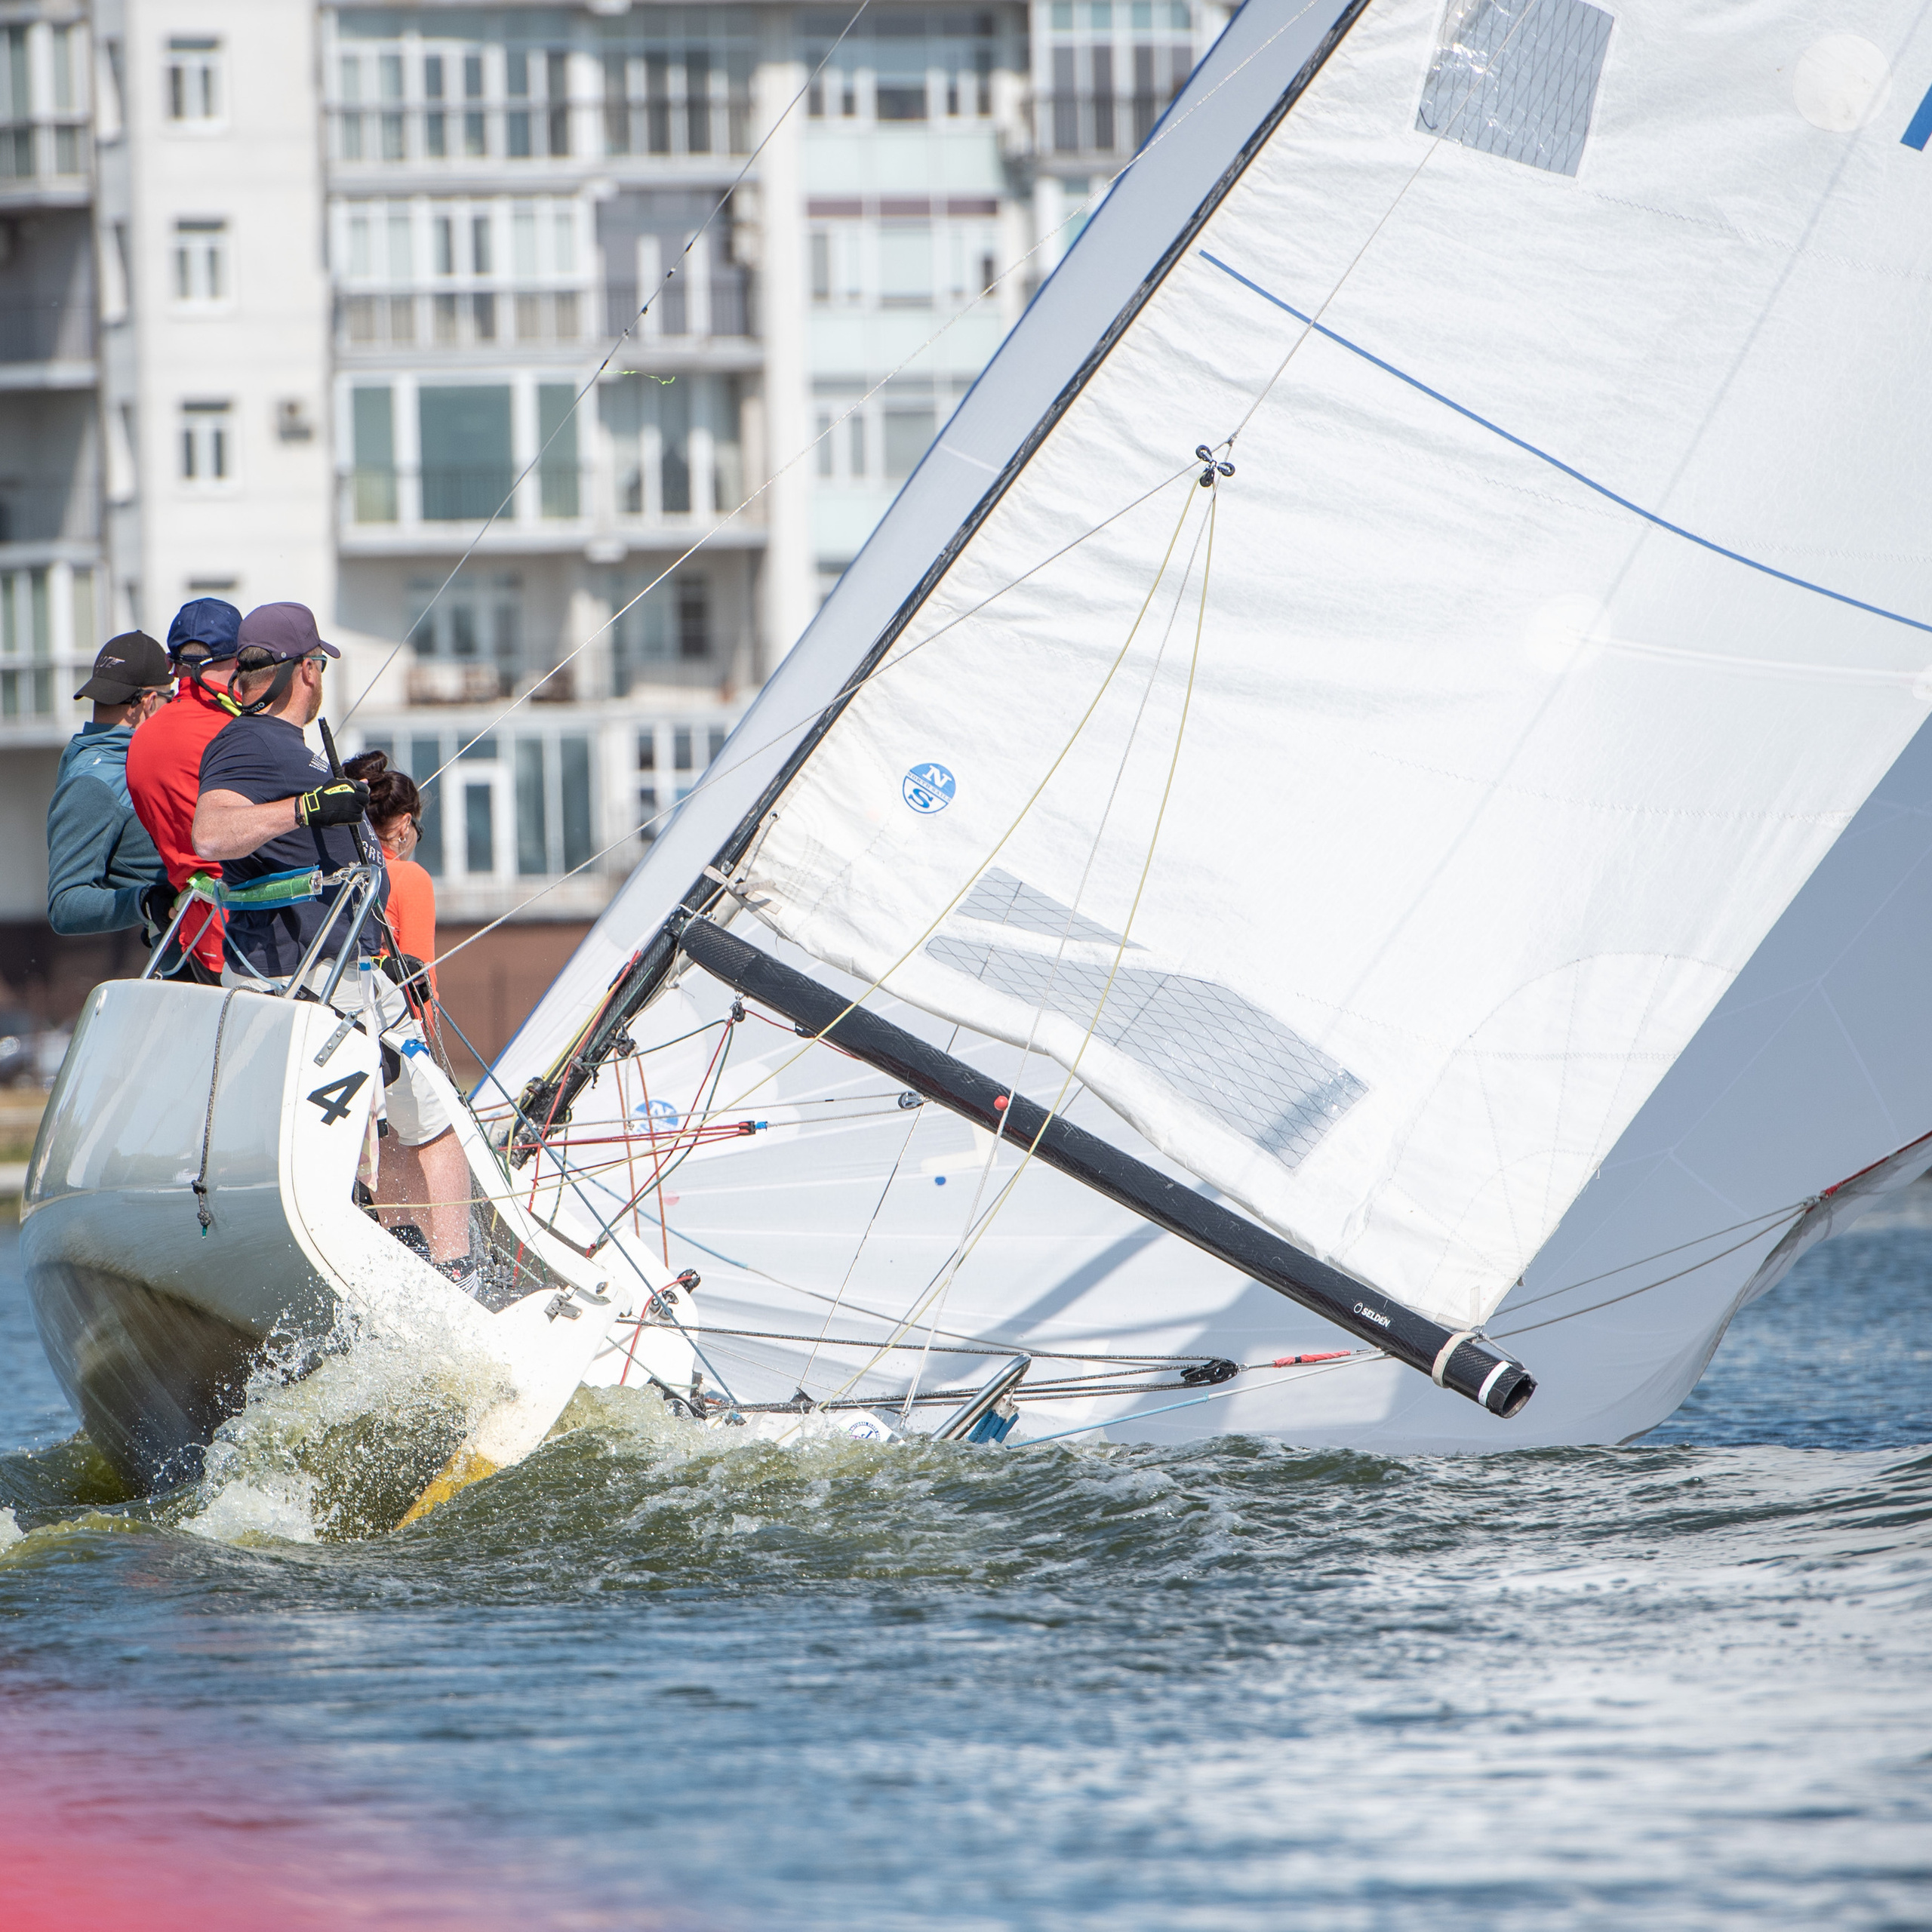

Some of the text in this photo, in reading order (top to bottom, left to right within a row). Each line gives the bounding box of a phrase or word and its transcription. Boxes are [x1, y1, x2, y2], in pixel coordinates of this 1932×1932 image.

[906, 771, 952, 802] NORTH SAILS
[921, 764, 953, 789] N
[907, 788, 934, 809] S
[306, 1070, 370, 1126] 4
[1361, 1307, 1391, 1327] SELDÉN
